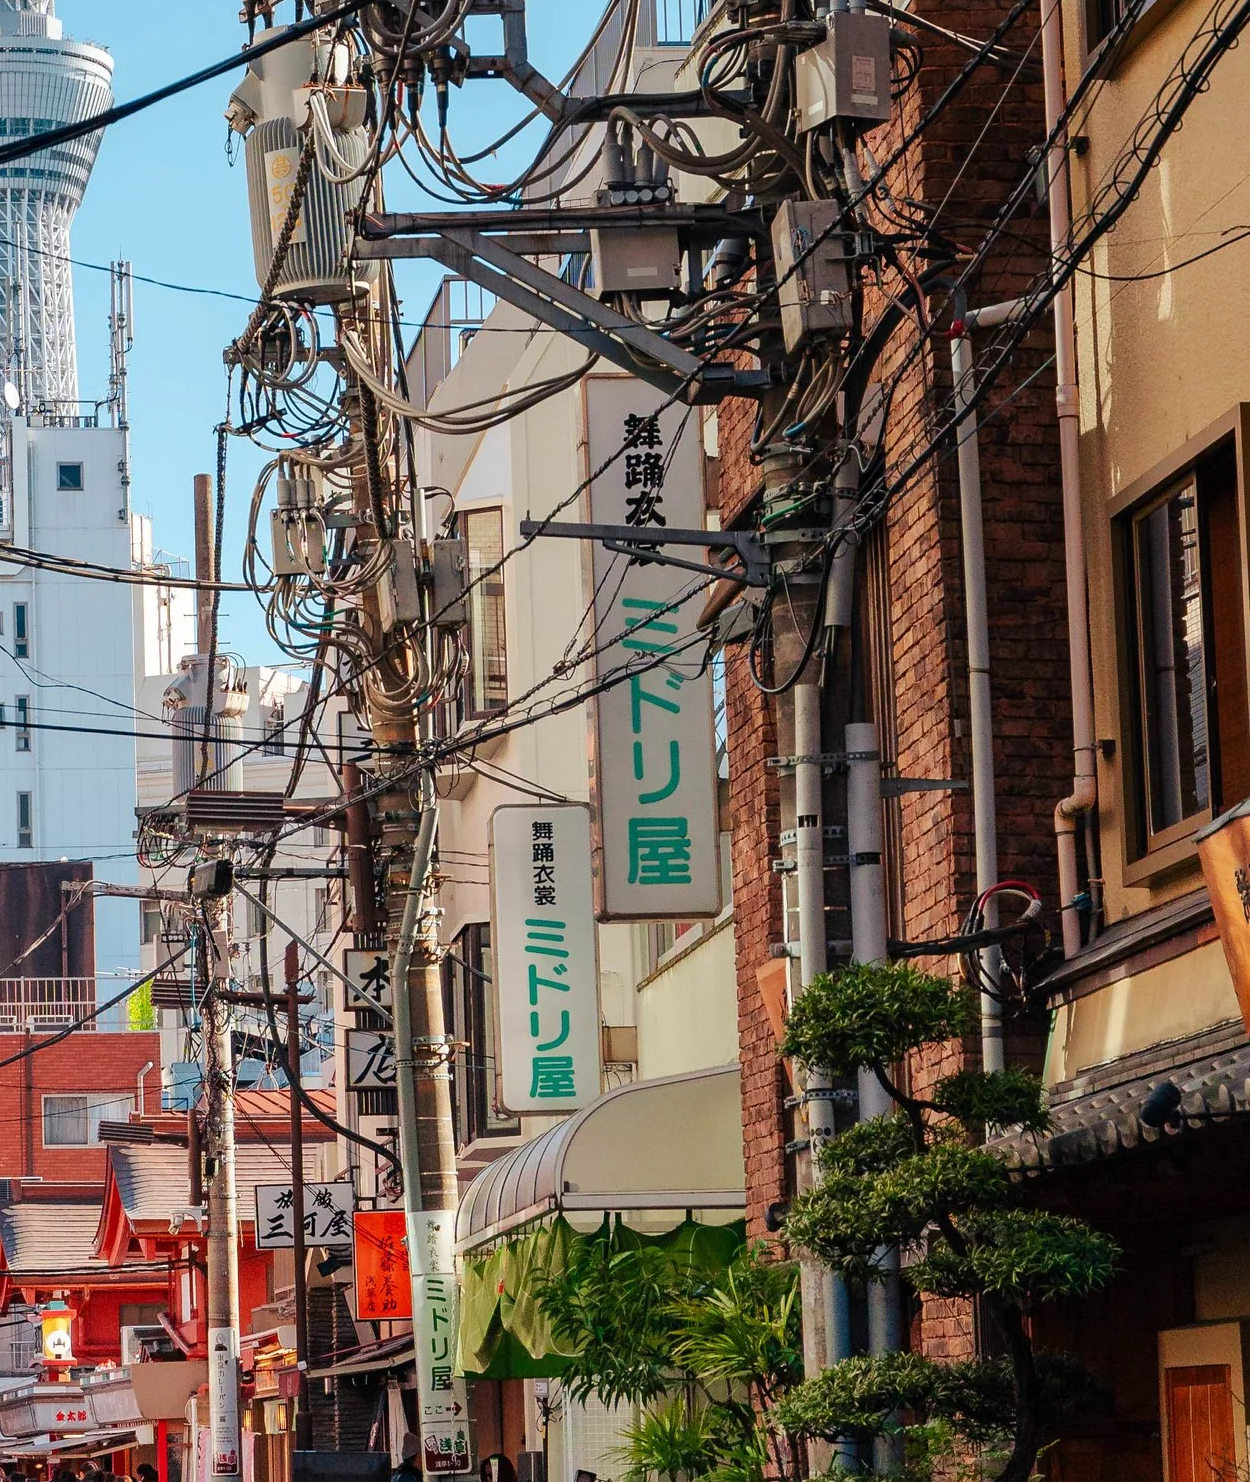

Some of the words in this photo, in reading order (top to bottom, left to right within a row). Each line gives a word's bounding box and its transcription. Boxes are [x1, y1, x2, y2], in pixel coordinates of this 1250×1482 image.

[622, 597, 692, 886] ミドリ屋
[531, 821, 556, 906] 舞踊衣裳
[524, 918, 577, 1099] ミドリ屋
[426, 1278, 453, 1392] ミドリ屋
[425, 1405, 443, 1415] ここ
